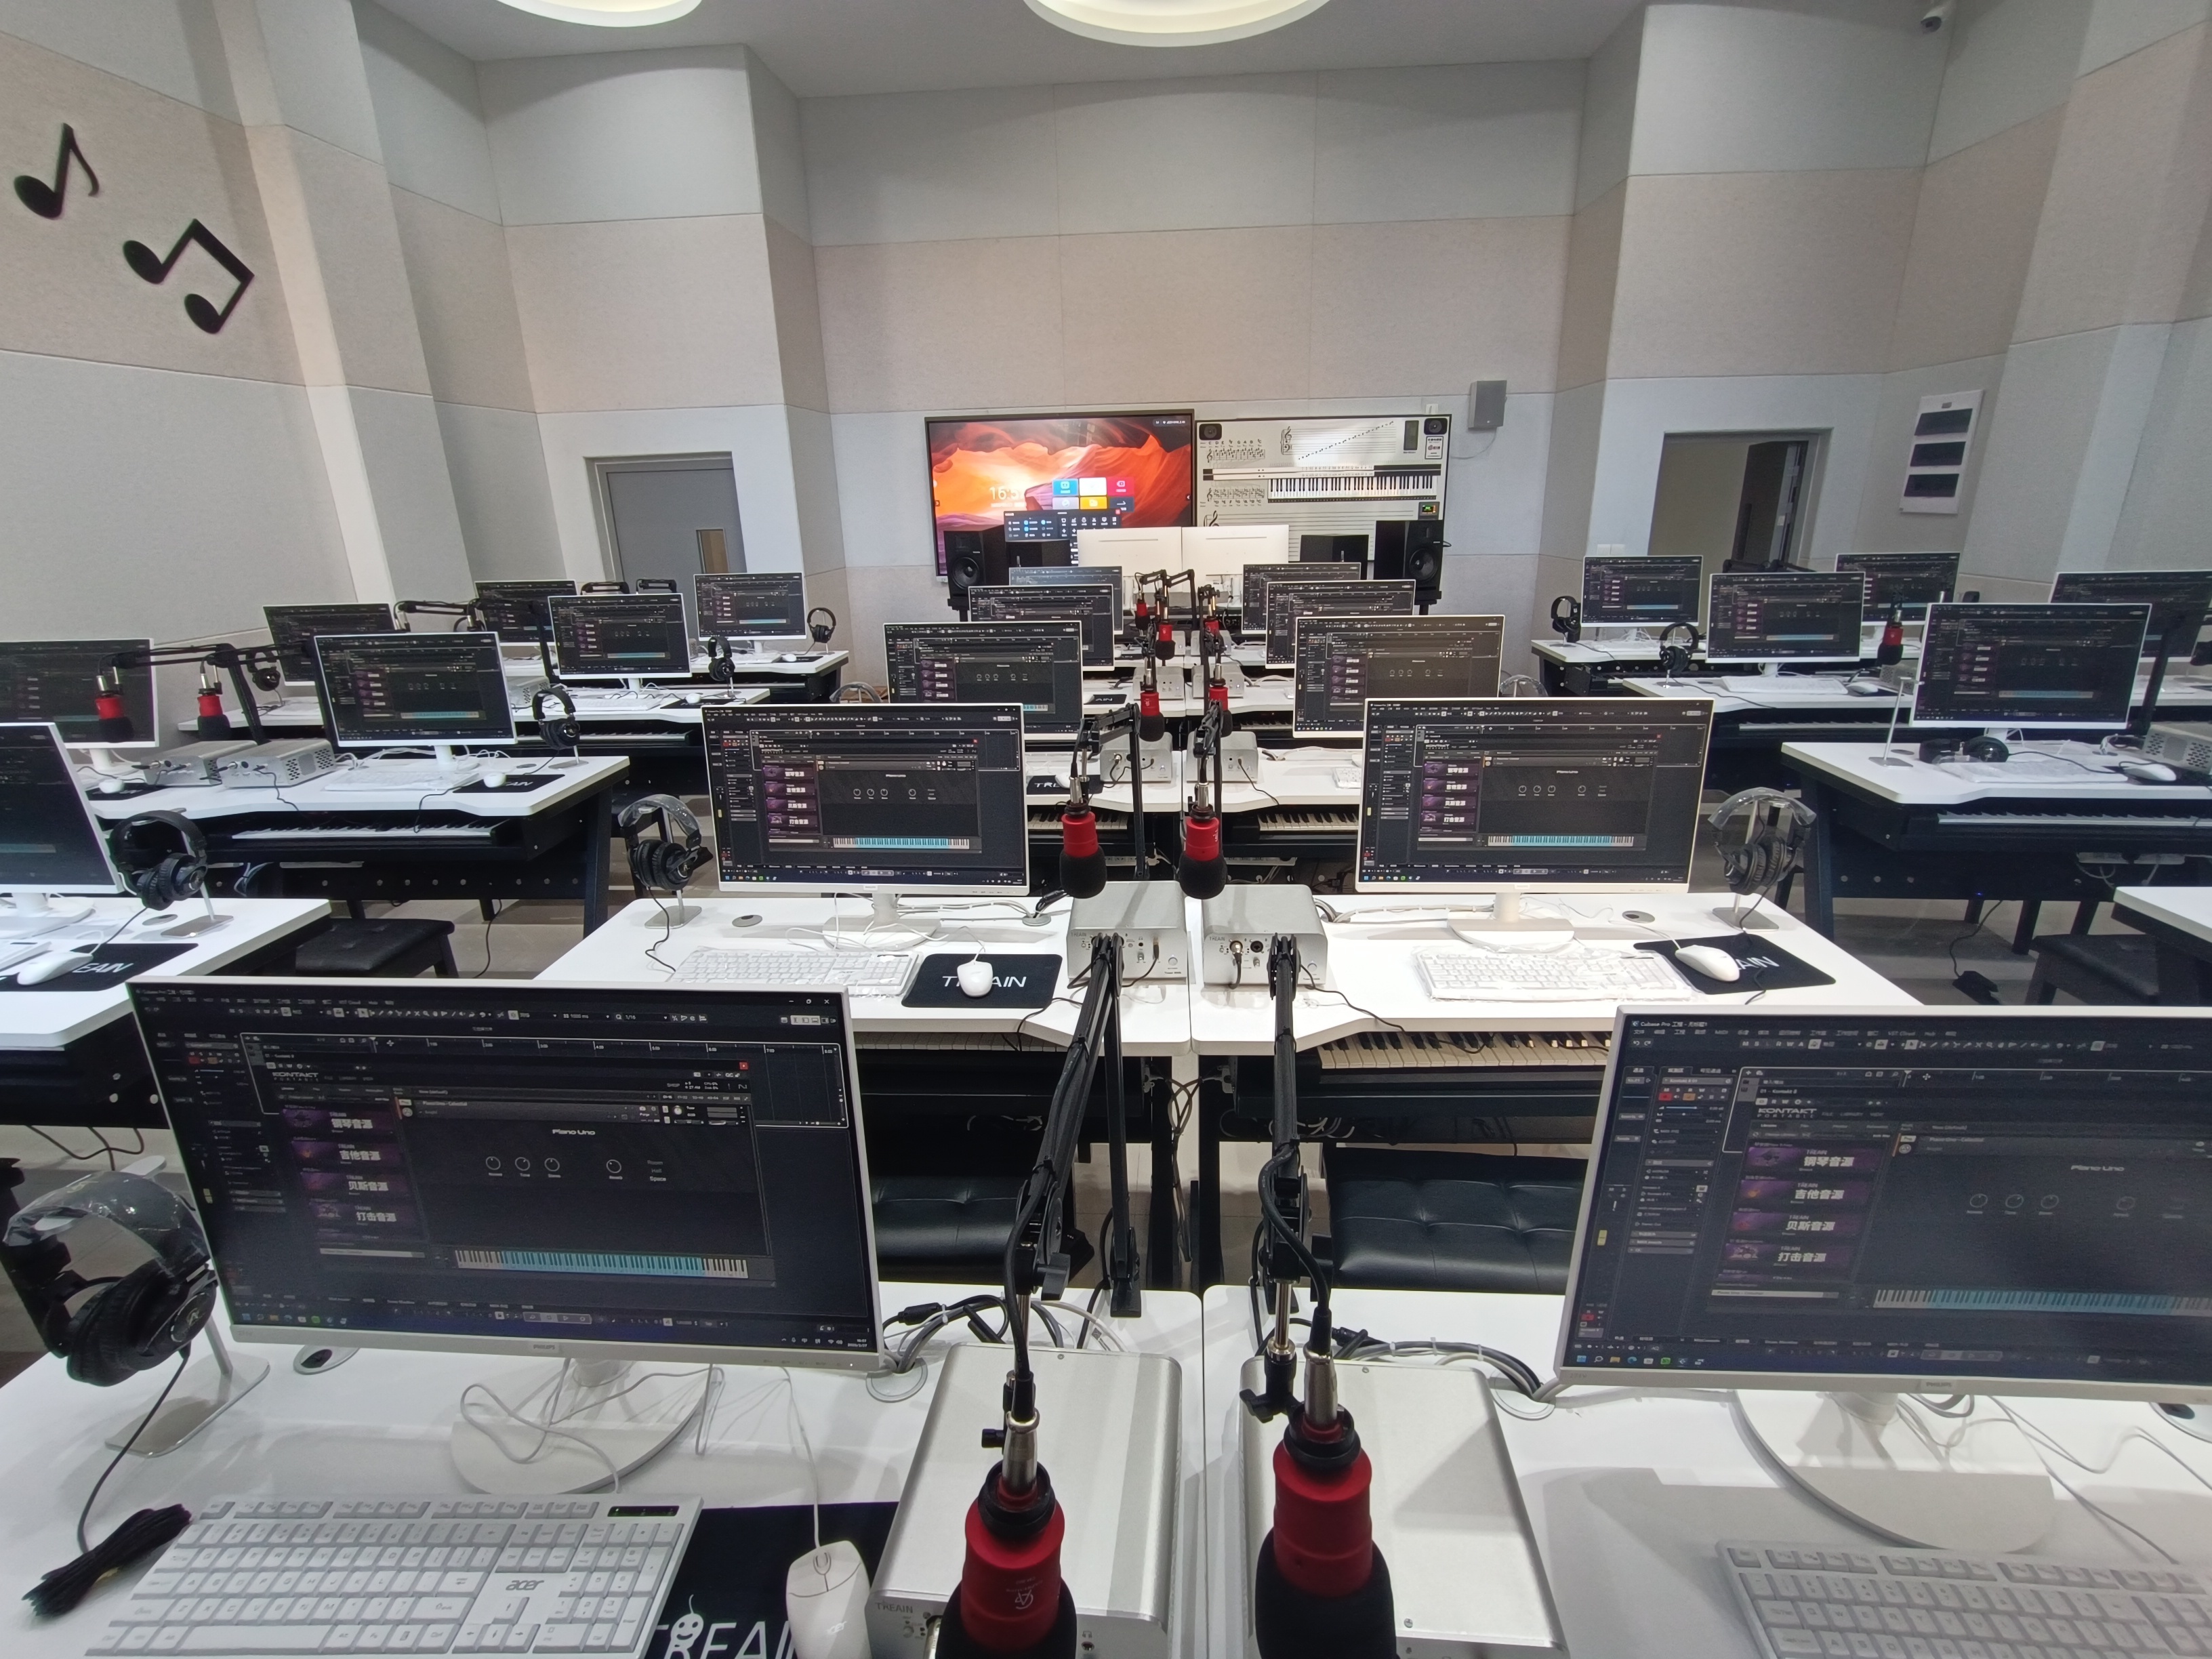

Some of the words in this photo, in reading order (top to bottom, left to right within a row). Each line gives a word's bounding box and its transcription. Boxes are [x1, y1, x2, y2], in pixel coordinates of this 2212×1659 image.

[73, 962, 134, 973] EAIN
[1736, 956, 1780, 970] AIN
[943, 976, 1027, 987] TAIN
[1803, 1156, 1855, 1167] 钢琴音源
[348, 1181, 389, 1191] 贝斯音源
[1795, 1189, 1845, 1200] 吉他音源
[356, 1212, 397, 1222] 打击音源
[1785, 1221, 1836, 1231] 贝斯音源
[1777, 1252, 1827, 1263] 打击音源
[506, 1579, 545, 1591] acer
[874, 1600, 914, 1614] TREAIN
